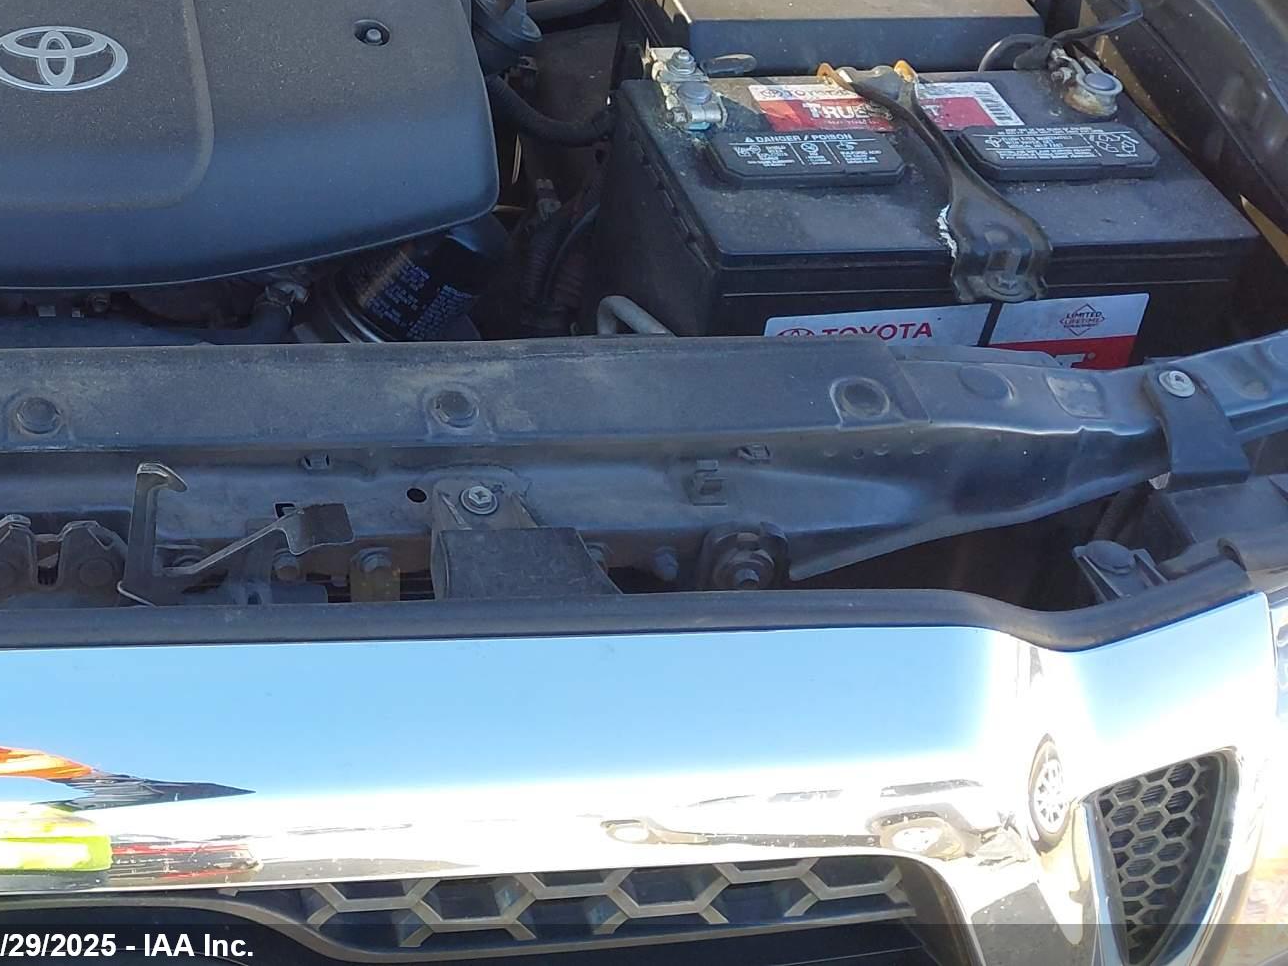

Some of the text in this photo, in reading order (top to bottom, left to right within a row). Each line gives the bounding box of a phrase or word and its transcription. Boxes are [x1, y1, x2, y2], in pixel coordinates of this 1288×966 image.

[754, 135, 802, 143] DANGER
[812, 133, 853, 141] POISON
[1066, 311, 1102, 319] LIMITED
